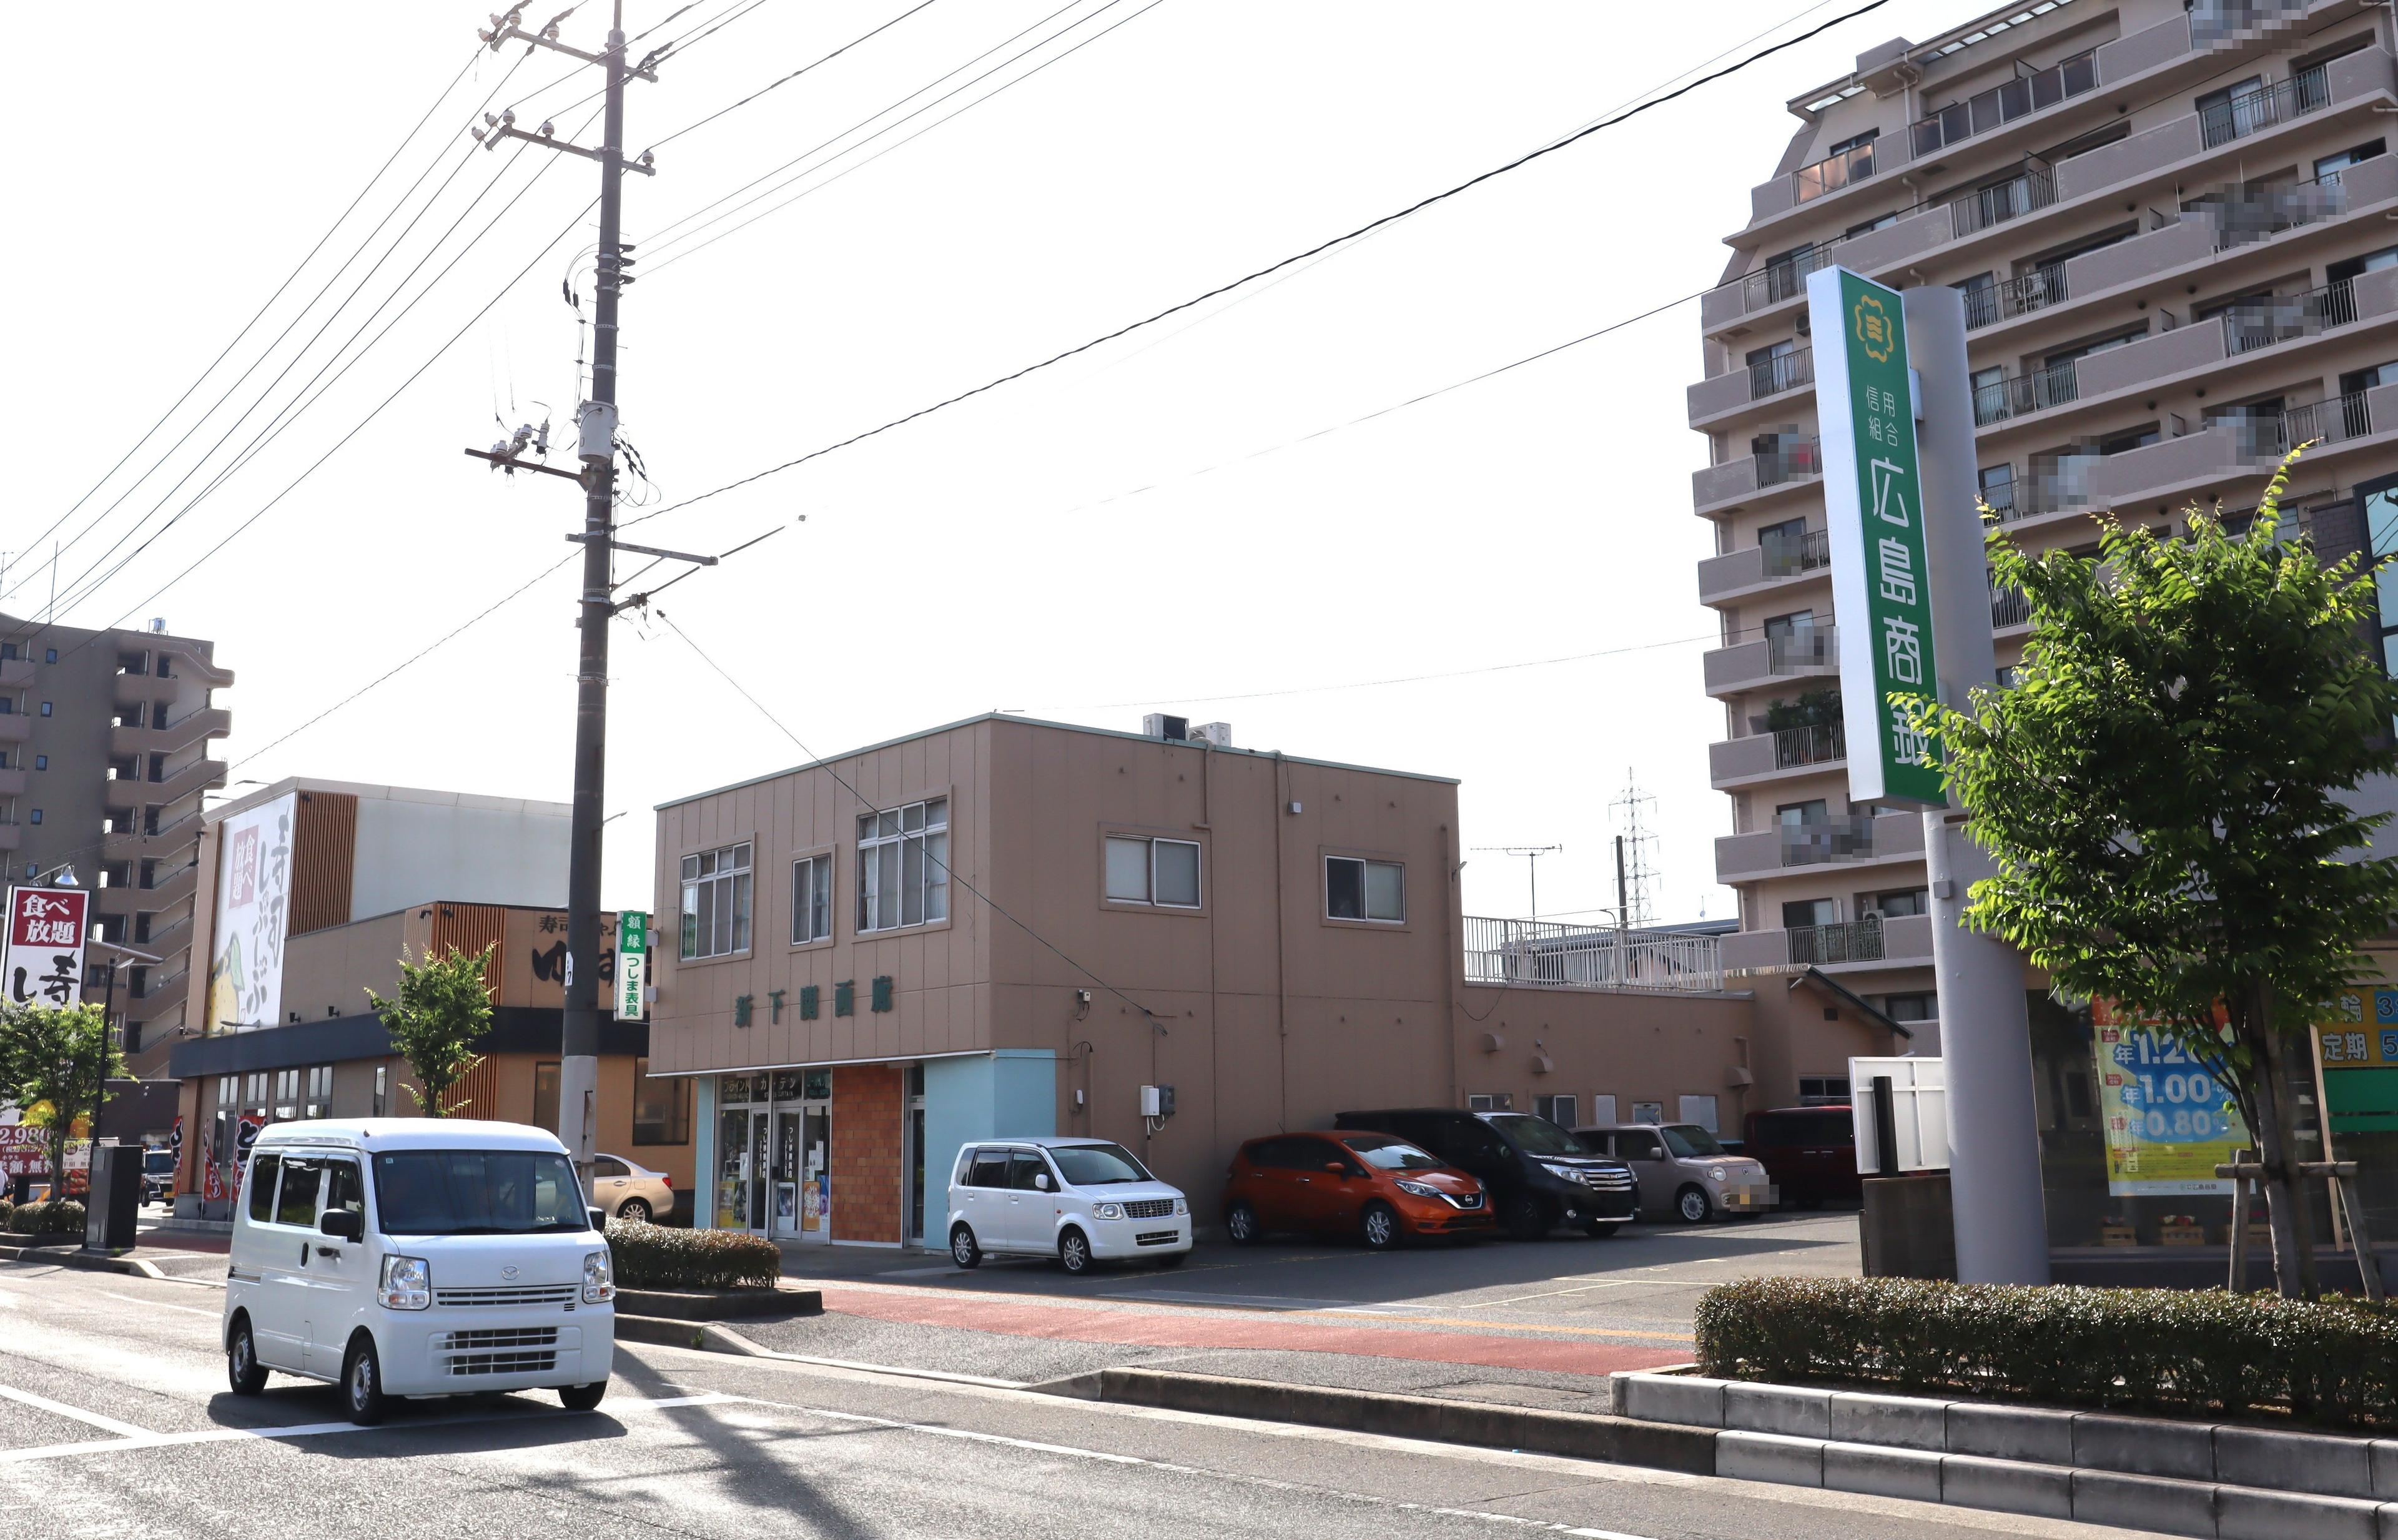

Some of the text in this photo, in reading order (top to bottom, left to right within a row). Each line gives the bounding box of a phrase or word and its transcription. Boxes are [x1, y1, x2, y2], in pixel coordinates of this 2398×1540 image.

[1866, 385, 1895, 417] 信用
[1868, 415, 1898, 447] 組合
[1870, 457, 1929, 767] 広島商銀
[232, 842, 245, 901] 放題
[242, 834, 255, 887] 食べ
[22, 894, 70, 918] 食べ
[25, 919, 75, 944] 放題
[627, 915, 641, 949] 額縁
[625, 957, 640, 1017] つしま表具
[2321, 1032, 2369, 1062] 定期
